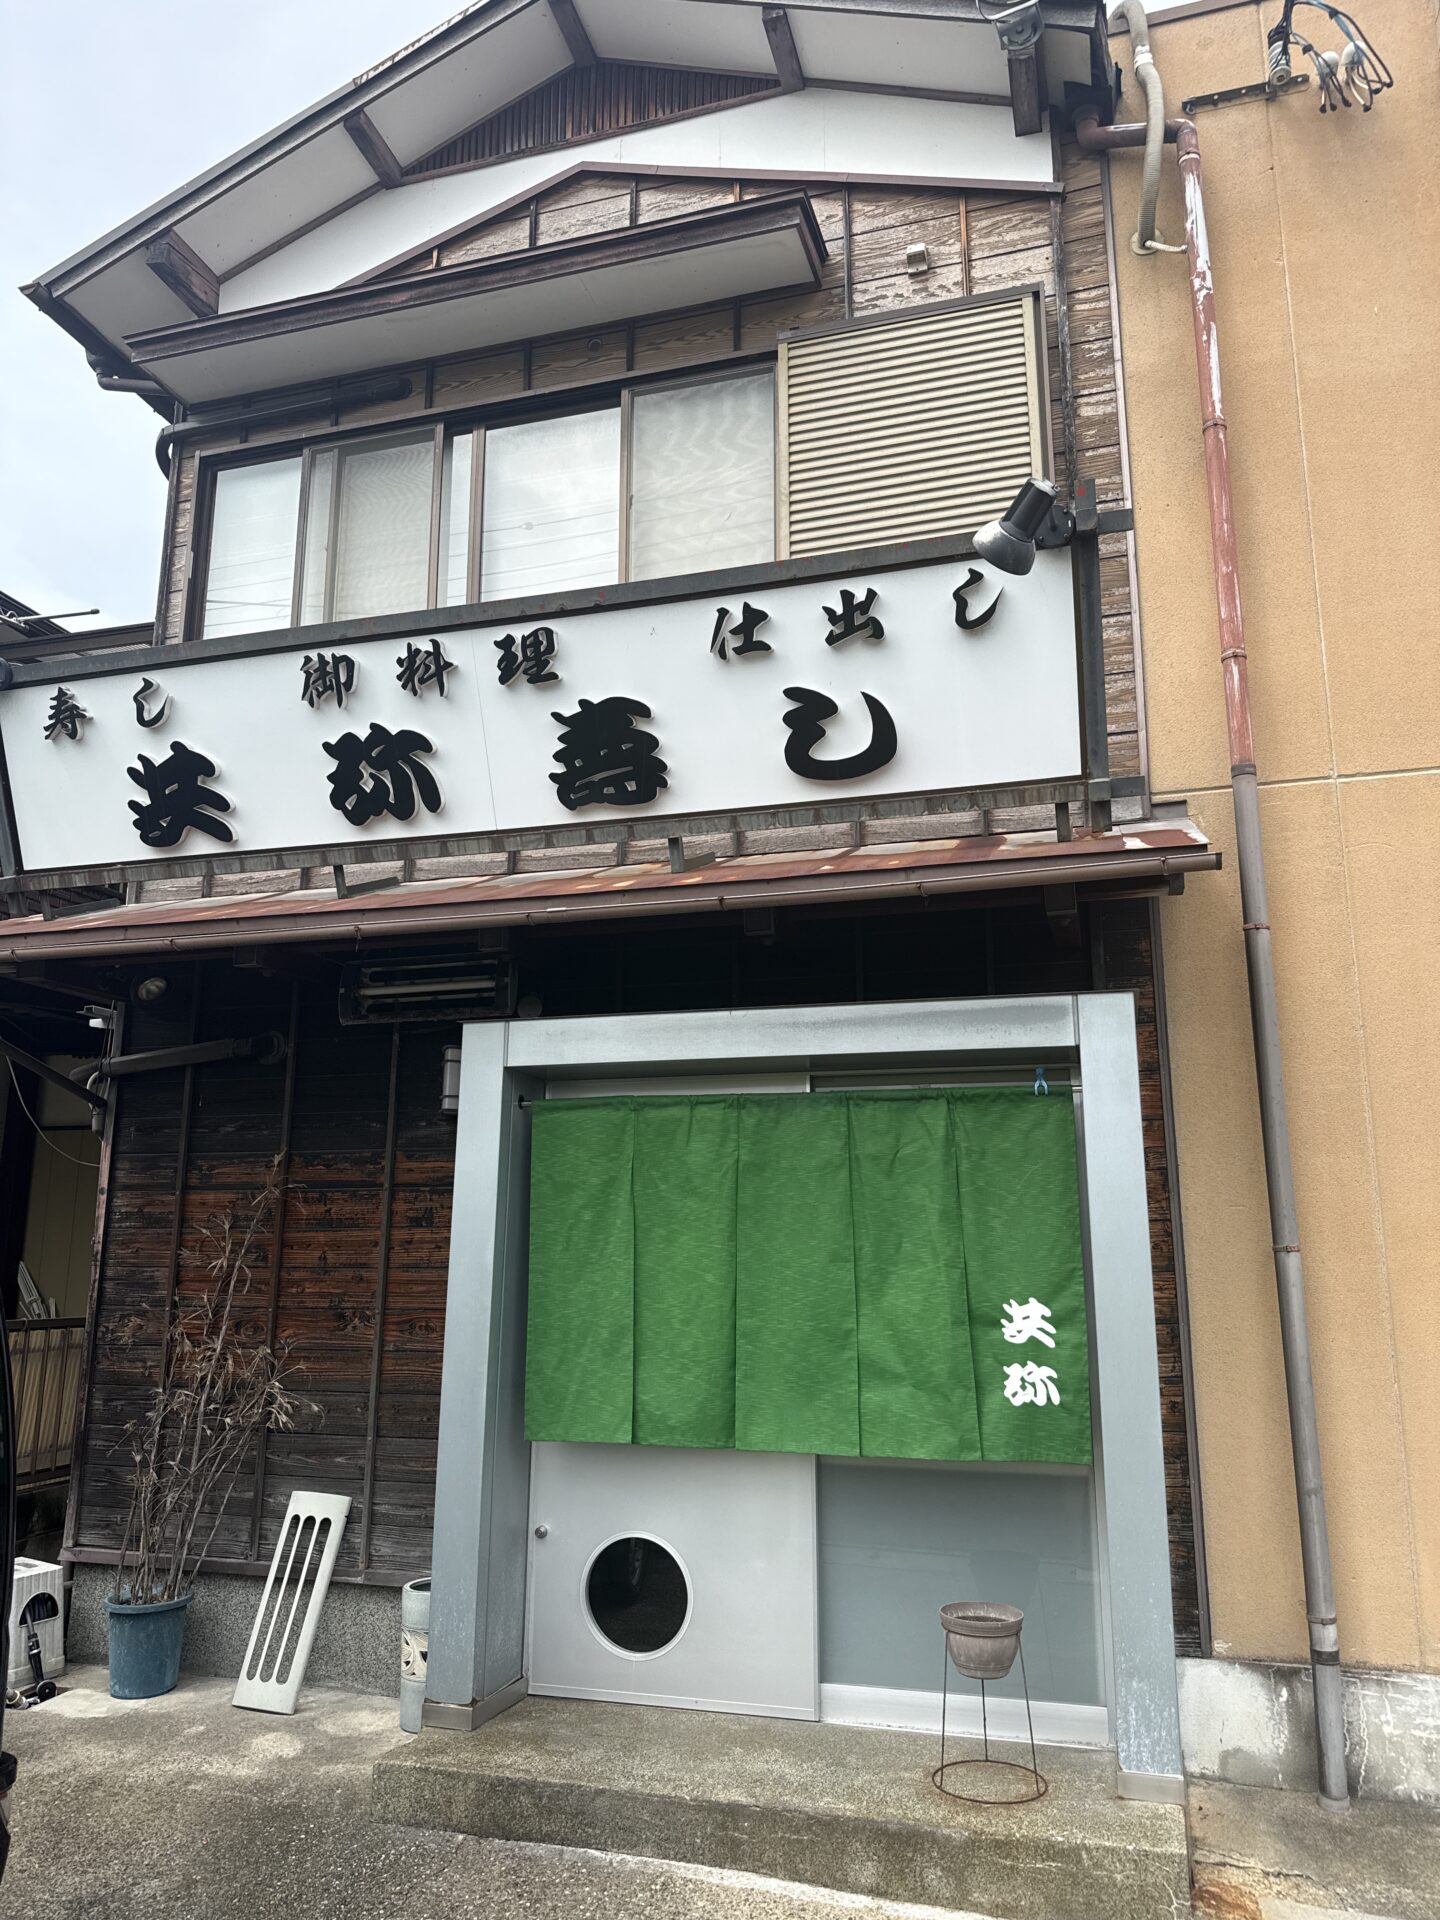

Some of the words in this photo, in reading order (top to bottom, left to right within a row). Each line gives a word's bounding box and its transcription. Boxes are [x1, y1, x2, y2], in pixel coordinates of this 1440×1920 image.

[43, 677, 173, 742] 寿し
[301, 625, 562, 710] 御料理
[709, 567, 1004, 662] 仕出し
